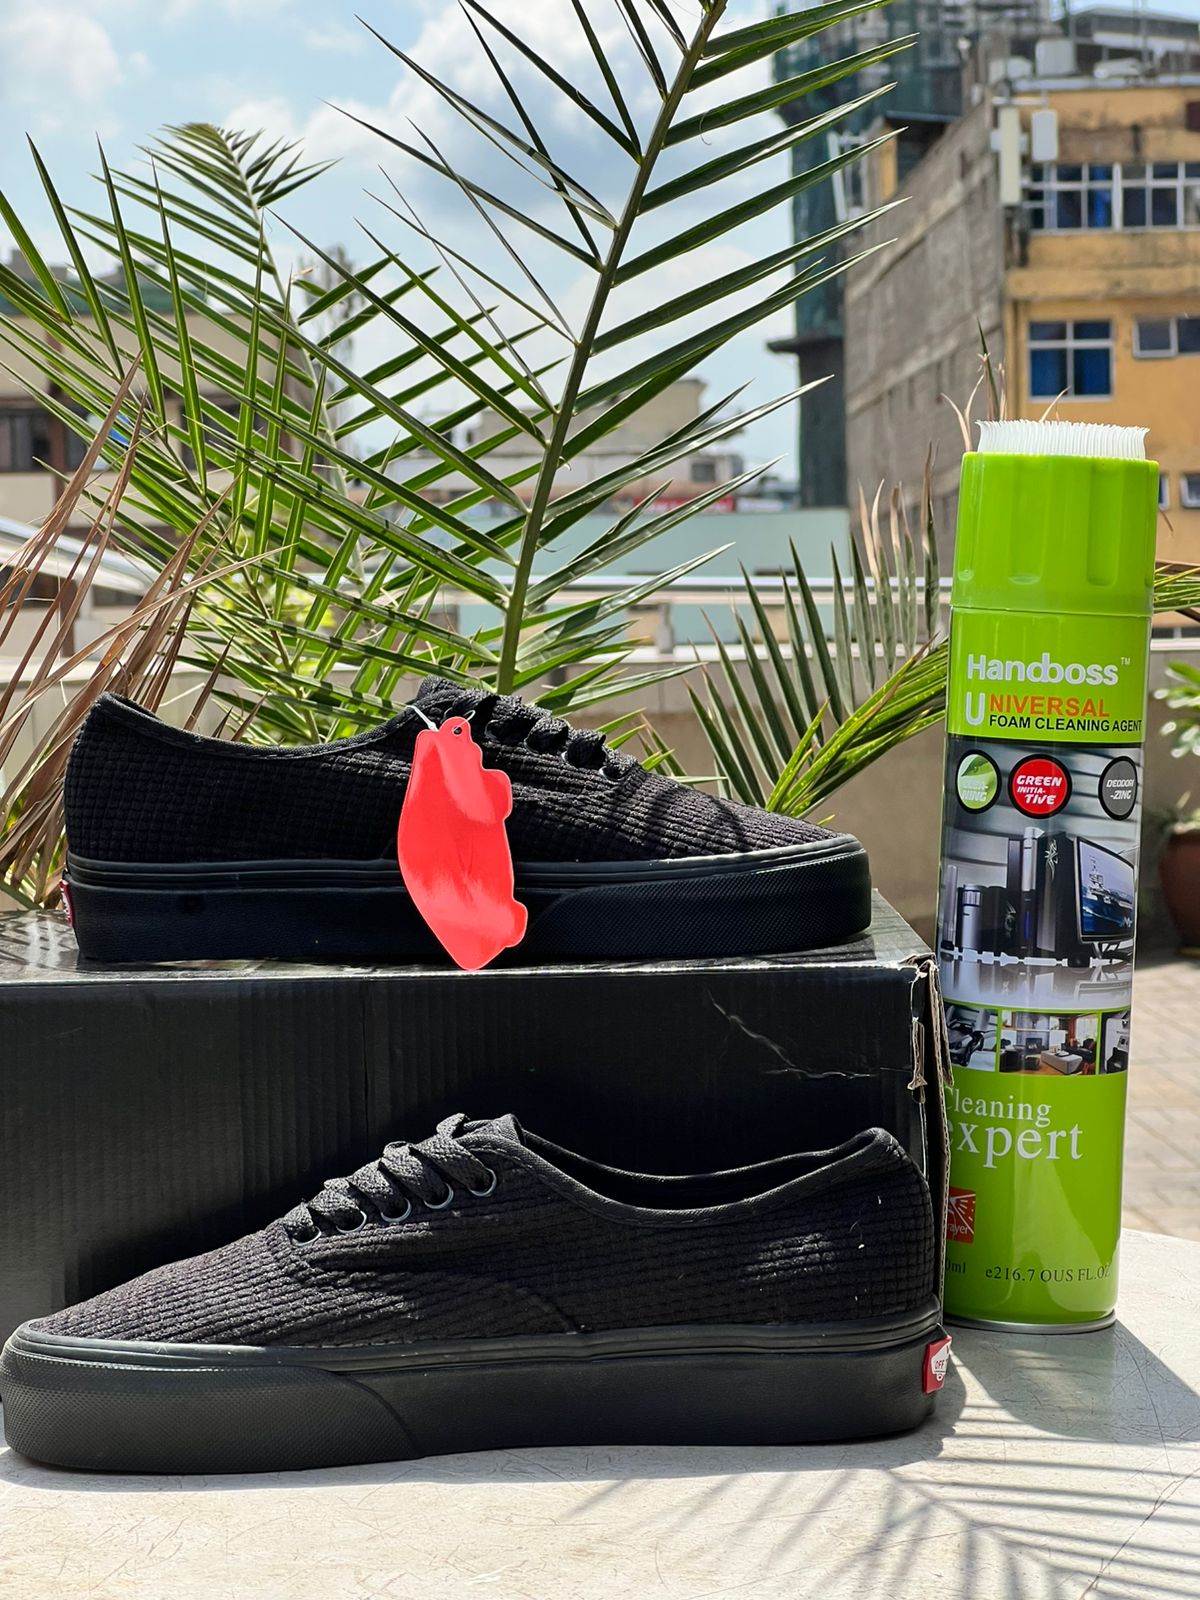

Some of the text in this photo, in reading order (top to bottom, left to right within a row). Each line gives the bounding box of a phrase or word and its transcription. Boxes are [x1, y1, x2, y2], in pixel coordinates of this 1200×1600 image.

[967, 652, 1118, 686] Handboss
[989, 714, 1142, 732] FOAM CLEANING AGENT
[1016, 775, 1063, 787] GREEN
[1017, 786, 1046, 794] INITIA-
[1024, 794, 1056, 805] TIVE
[985, 1266, 1035, 1281] e216.7
